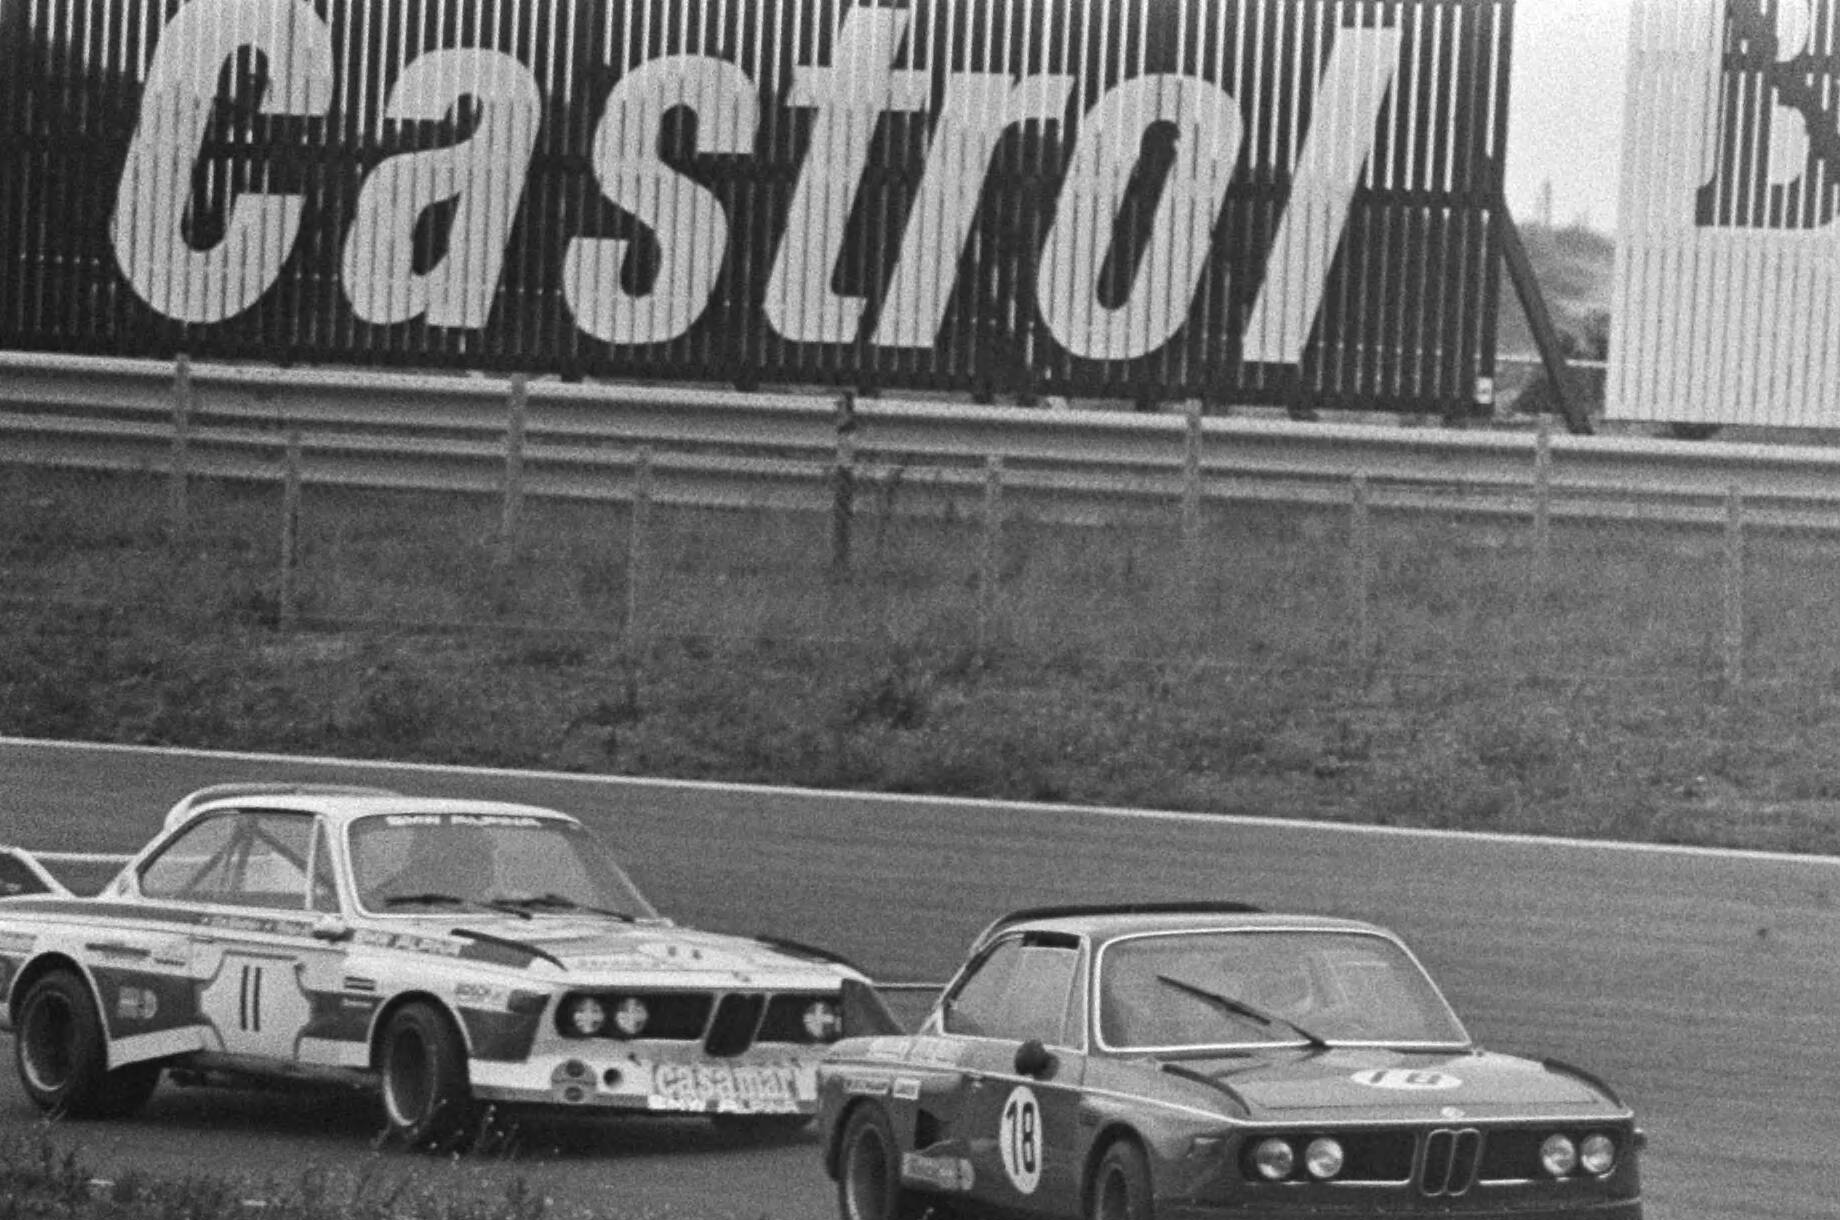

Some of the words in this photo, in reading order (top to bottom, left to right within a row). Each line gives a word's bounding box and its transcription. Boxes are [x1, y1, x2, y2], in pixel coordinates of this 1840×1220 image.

[110, 0, 1399, 363] Castrol
[240, 964, 261, 1032] 11
[1007, 1100, 1036, 1176] 18
